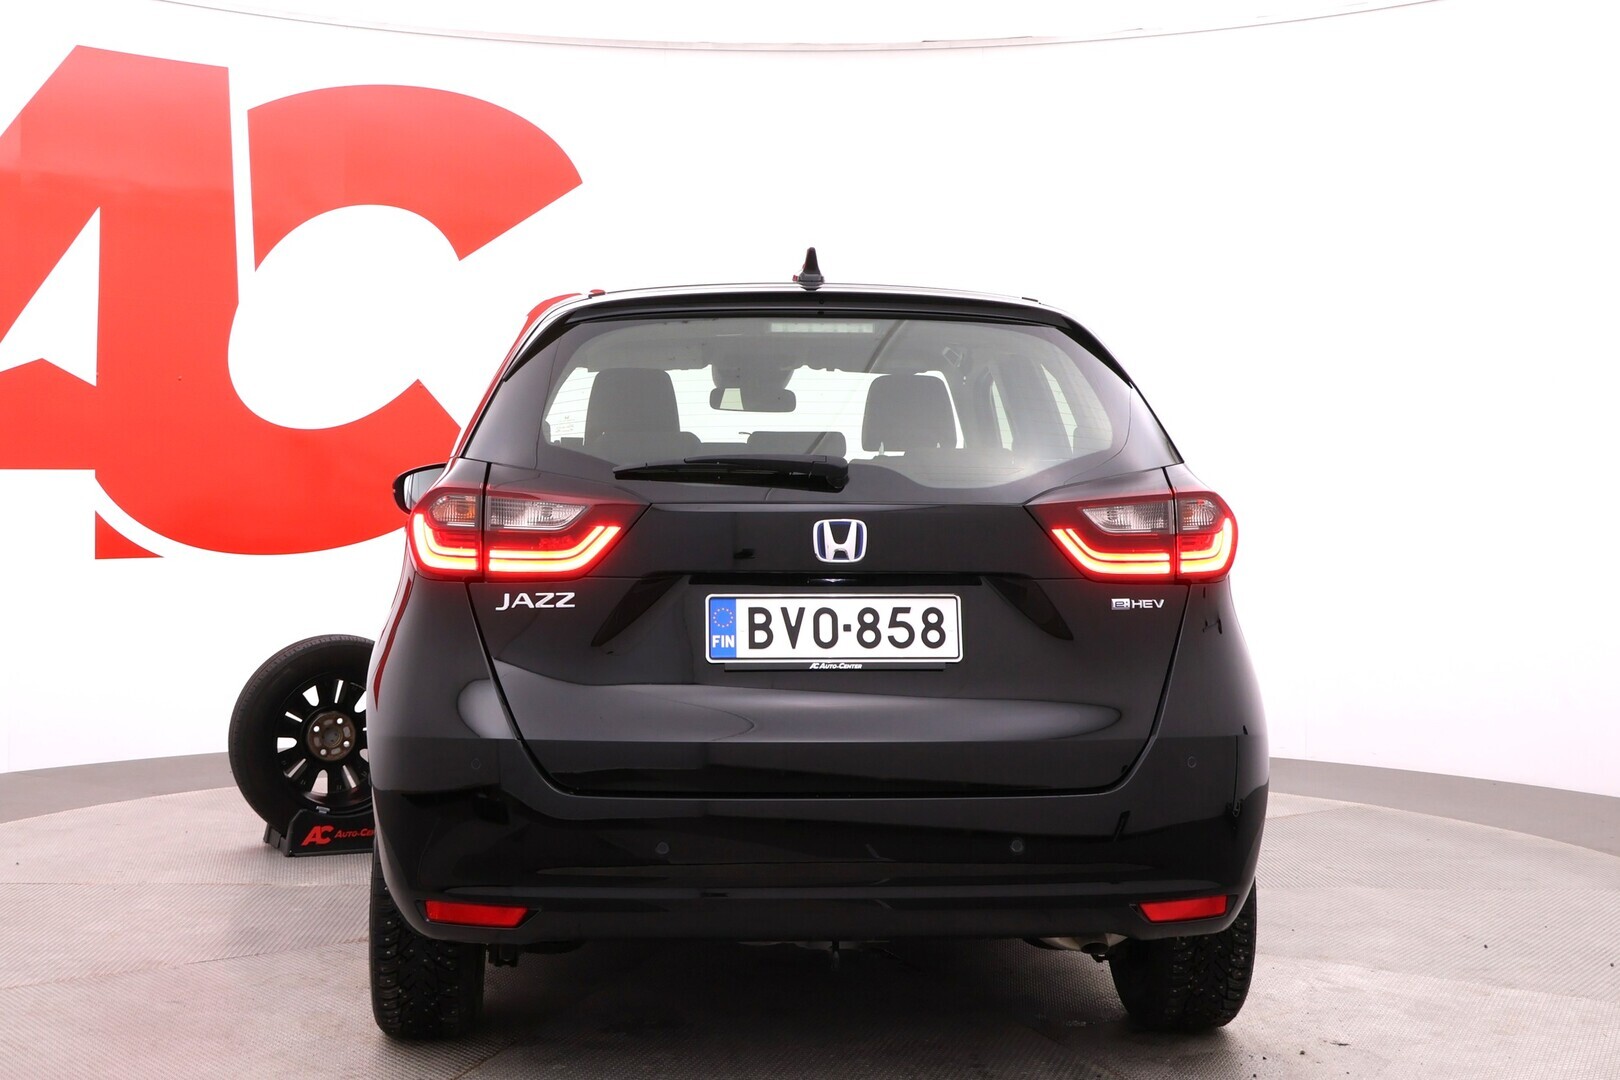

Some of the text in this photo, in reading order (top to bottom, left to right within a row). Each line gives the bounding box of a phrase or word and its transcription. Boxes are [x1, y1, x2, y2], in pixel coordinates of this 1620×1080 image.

[495, 592, 576, 611] JAZZ
[748, 606, 946, 650] BVO-858
[712, 634, 735, 648] FIN
[301, 825, 334, 846] AC
